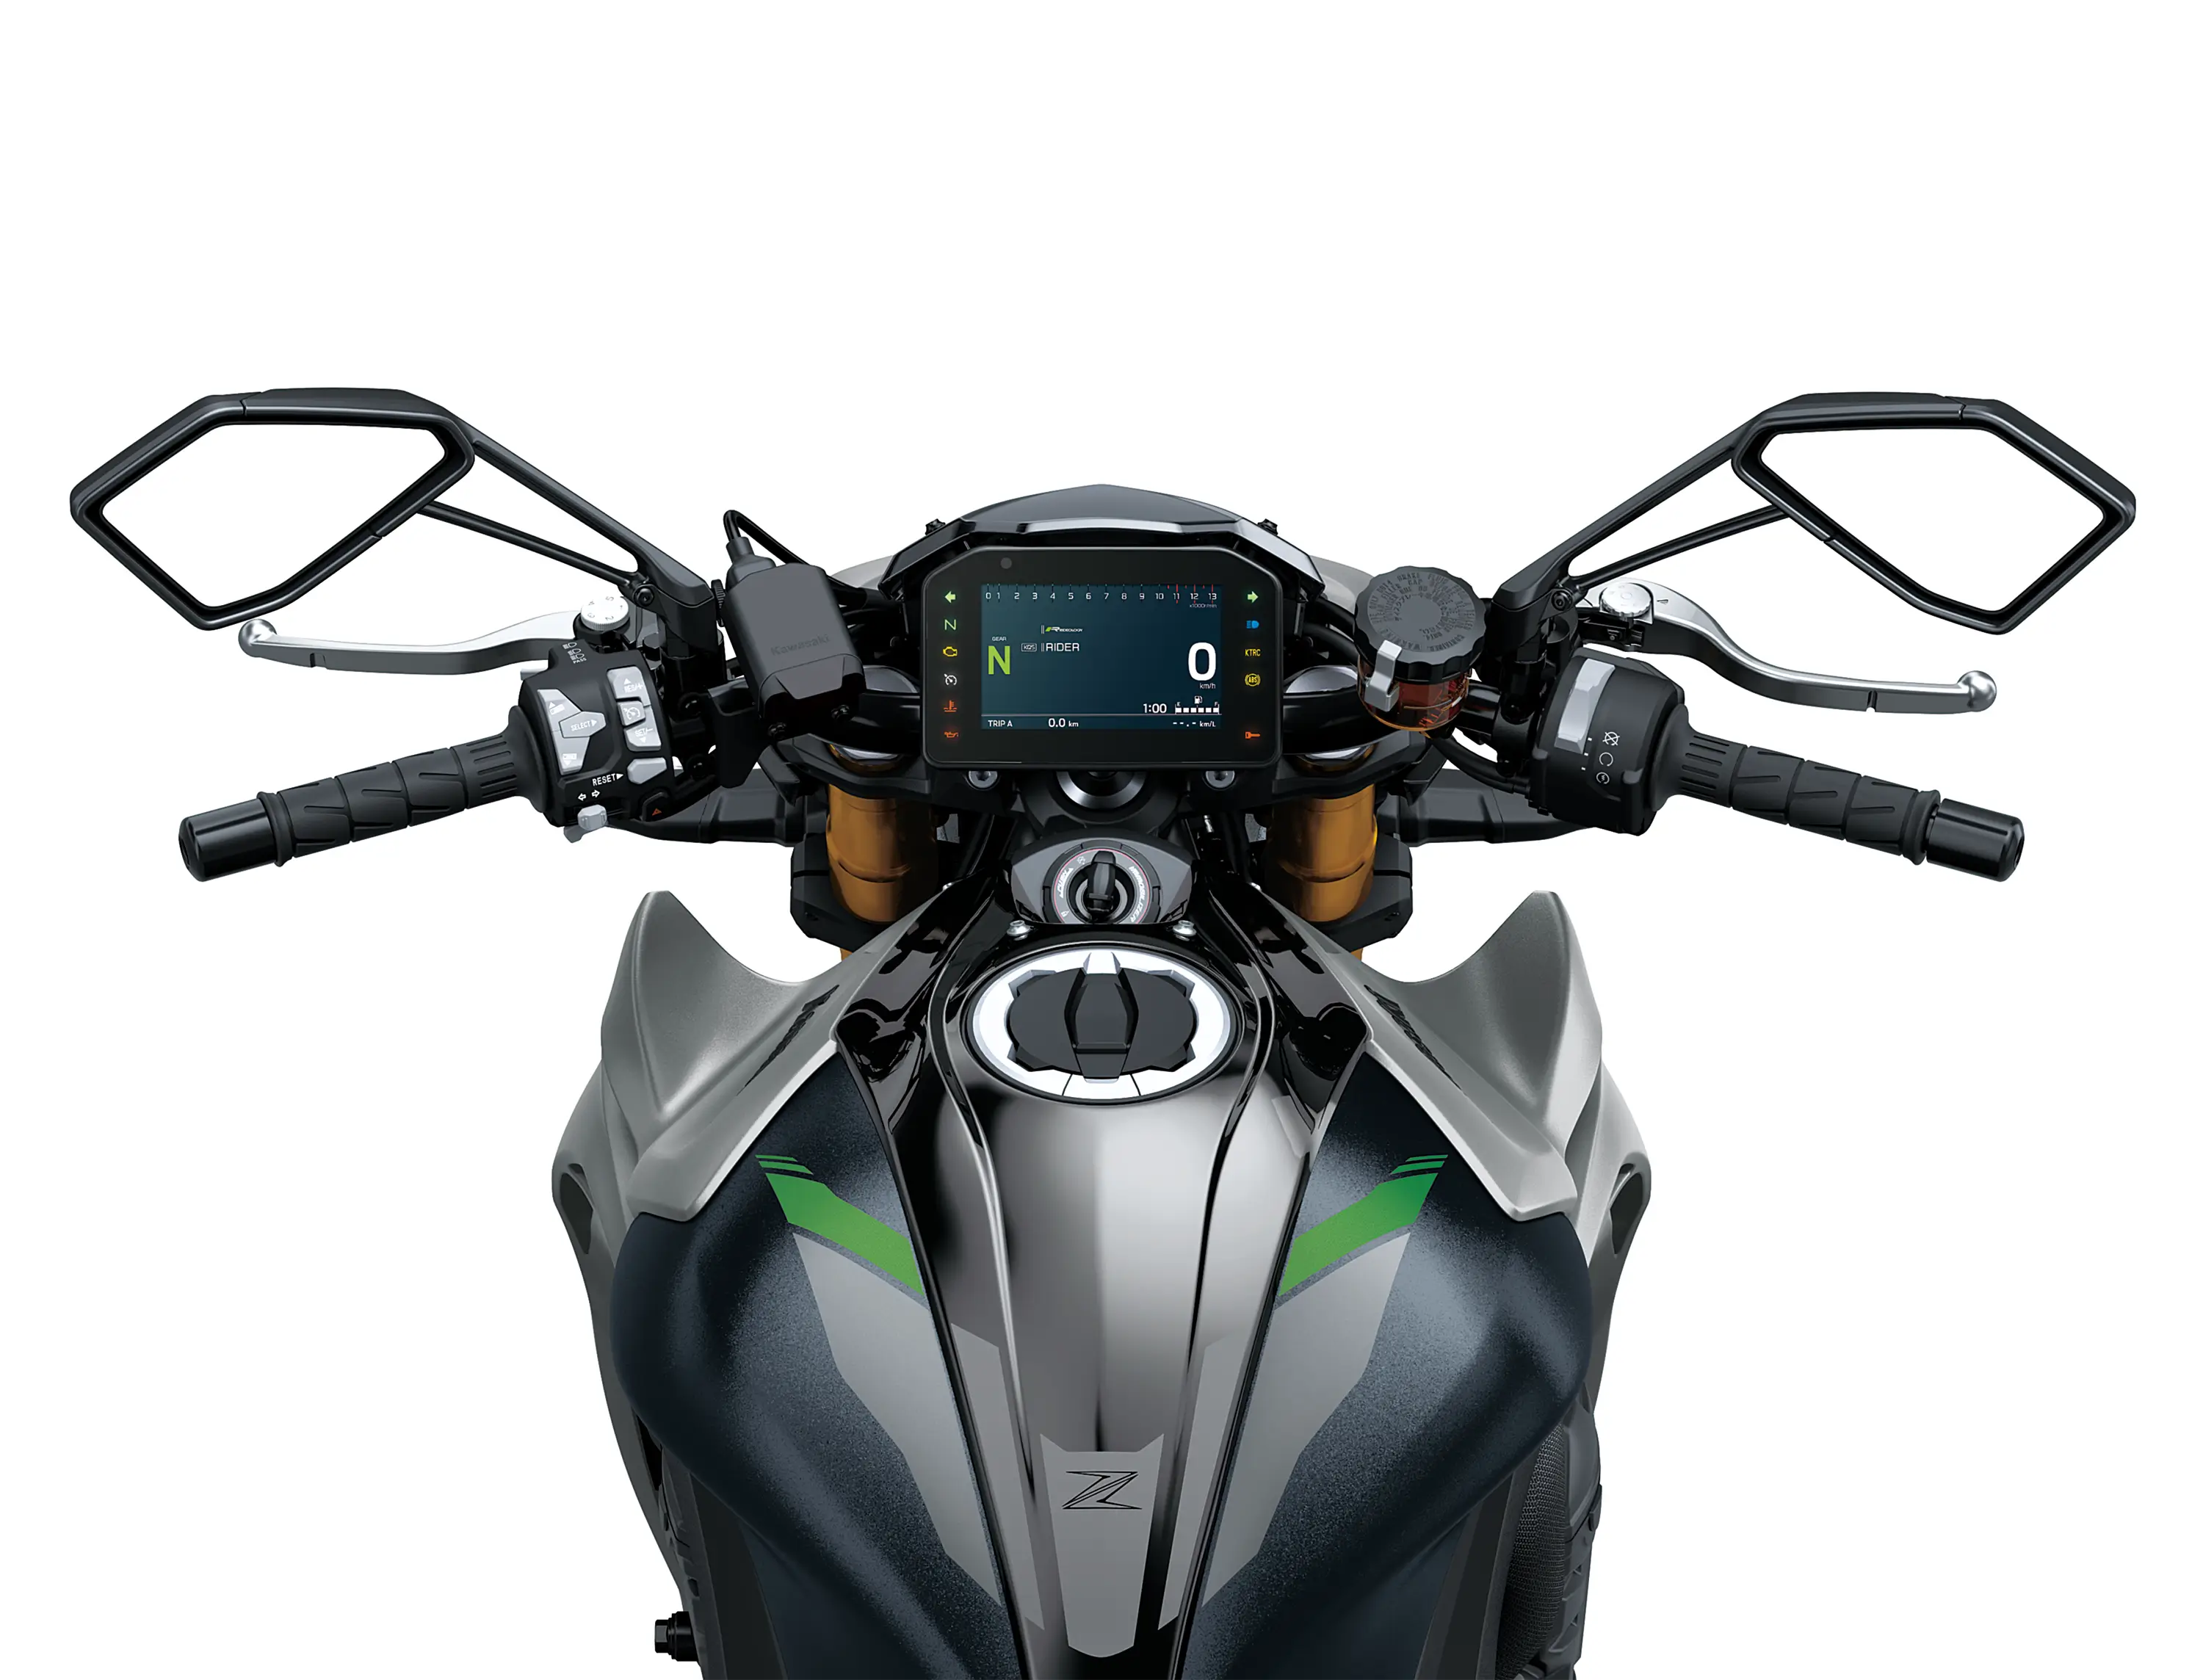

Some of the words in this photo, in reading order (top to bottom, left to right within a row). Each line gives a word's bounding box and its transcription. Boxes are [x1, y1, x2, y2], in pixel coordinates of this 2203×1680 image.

[944, 619, 956, 631] N
[771, 634, 831, 656] Kawasaki
[1046, 643, 1079, 652] RIDER
[988, 645, 1010, 675] N
[1187, 642, 1217, 681] 0
[1143, 703, 1167, 714] 1:00
[571, 720, 591, 731] SELECT
[988, 720, 1006, 728] TRIP
[1006, 720, 1013, 728] A
[1048, 718, 1066, 728] 0.0
[593, 773, 616, 786] RESET
